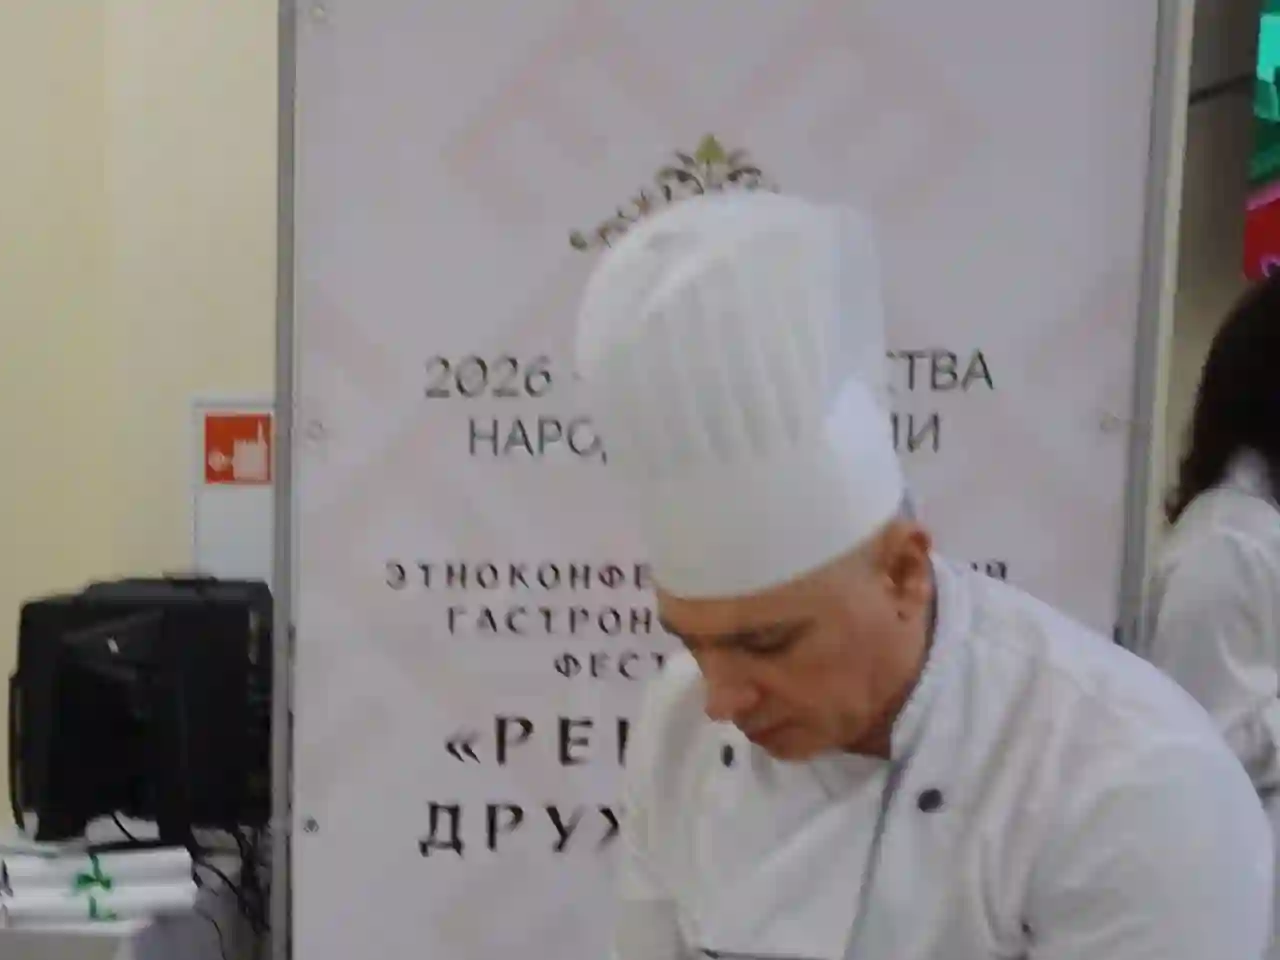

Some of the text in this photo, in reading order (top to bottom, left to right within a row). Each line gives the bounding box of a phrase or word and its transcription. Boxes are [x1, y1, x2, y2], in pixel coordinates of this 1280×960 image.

[424, 349, 994, 398] 2026 ТВА
[469, 416, 608, 465] НАРО
